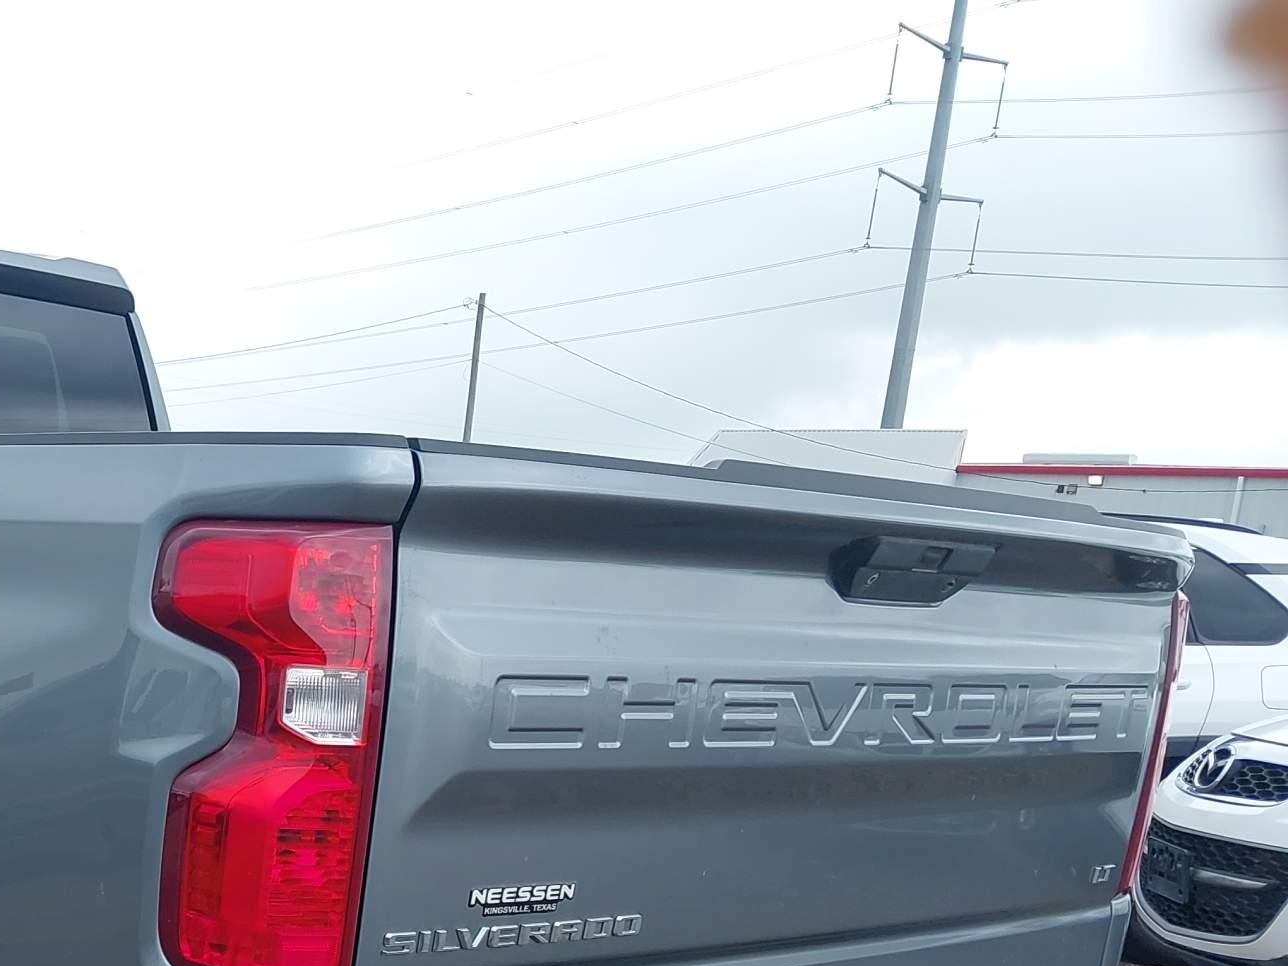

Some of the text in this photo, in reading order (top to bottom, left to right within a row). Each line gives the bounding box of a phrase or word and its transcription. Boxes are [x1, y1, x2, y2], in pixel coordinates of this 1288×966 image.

[488, 673, 1150, 749] CHEVROLET
[1091, 864, 1117, 884] LT
[470, 884, 575, 905] NEESSEN
[483, 903, 557, 915] KINGSVILLE, TEXAS
[380, 914, 642, 955] SILVERADO
